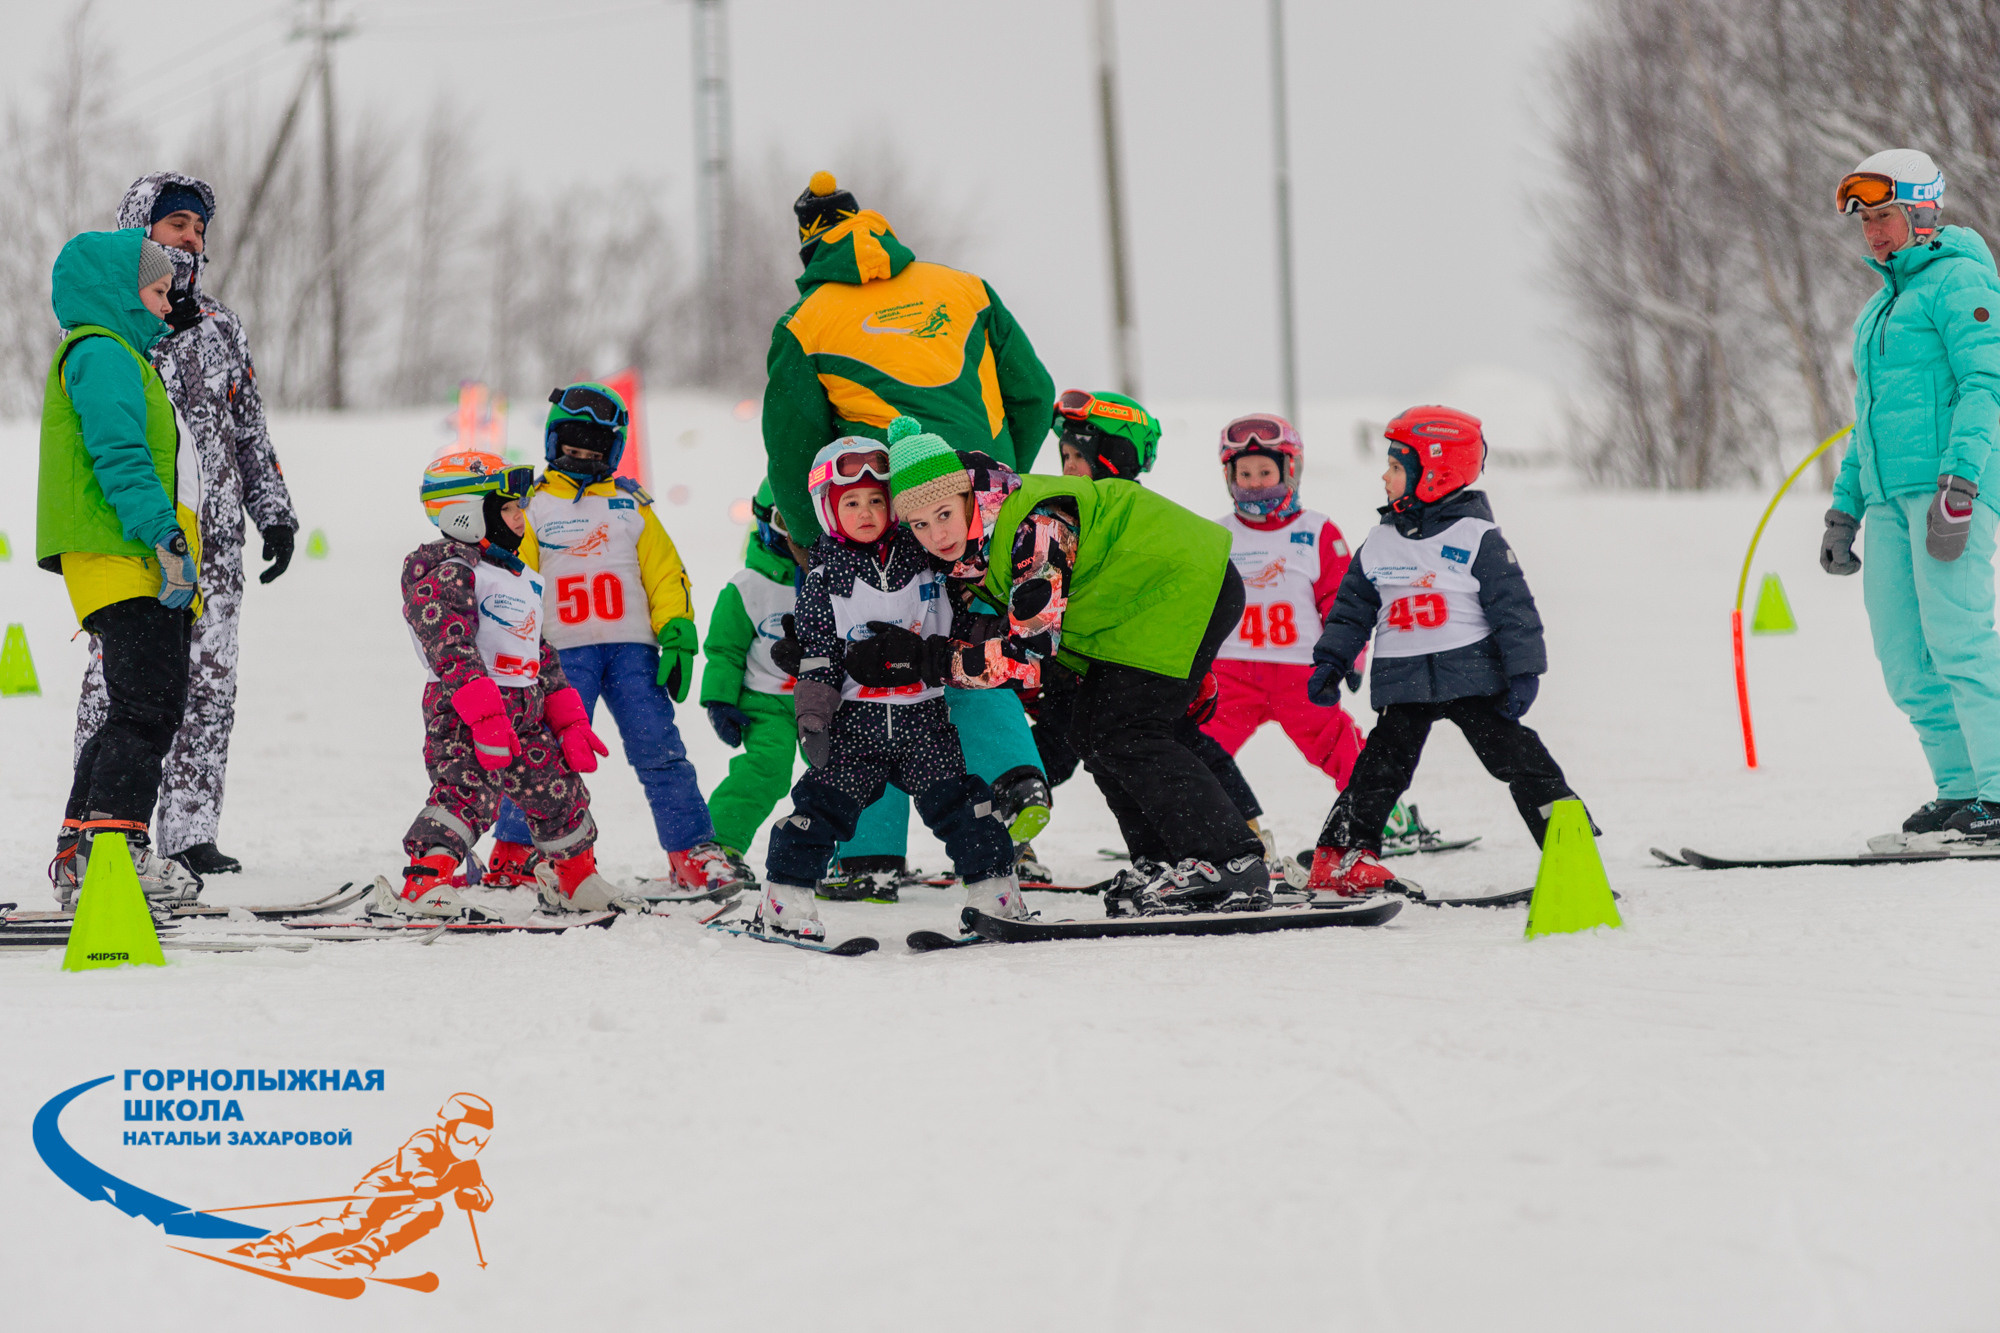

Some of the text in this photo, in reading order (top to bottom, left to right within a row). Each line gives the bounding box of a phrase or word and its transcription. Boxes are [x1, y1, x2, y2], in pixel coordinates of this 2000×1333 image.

[1017, 555, 1036, 570] ROXY
[556, 573, 624, 625] 50
[1388, 593, 1448, 632] 45
[1240, 601, 1298, 648] 48
